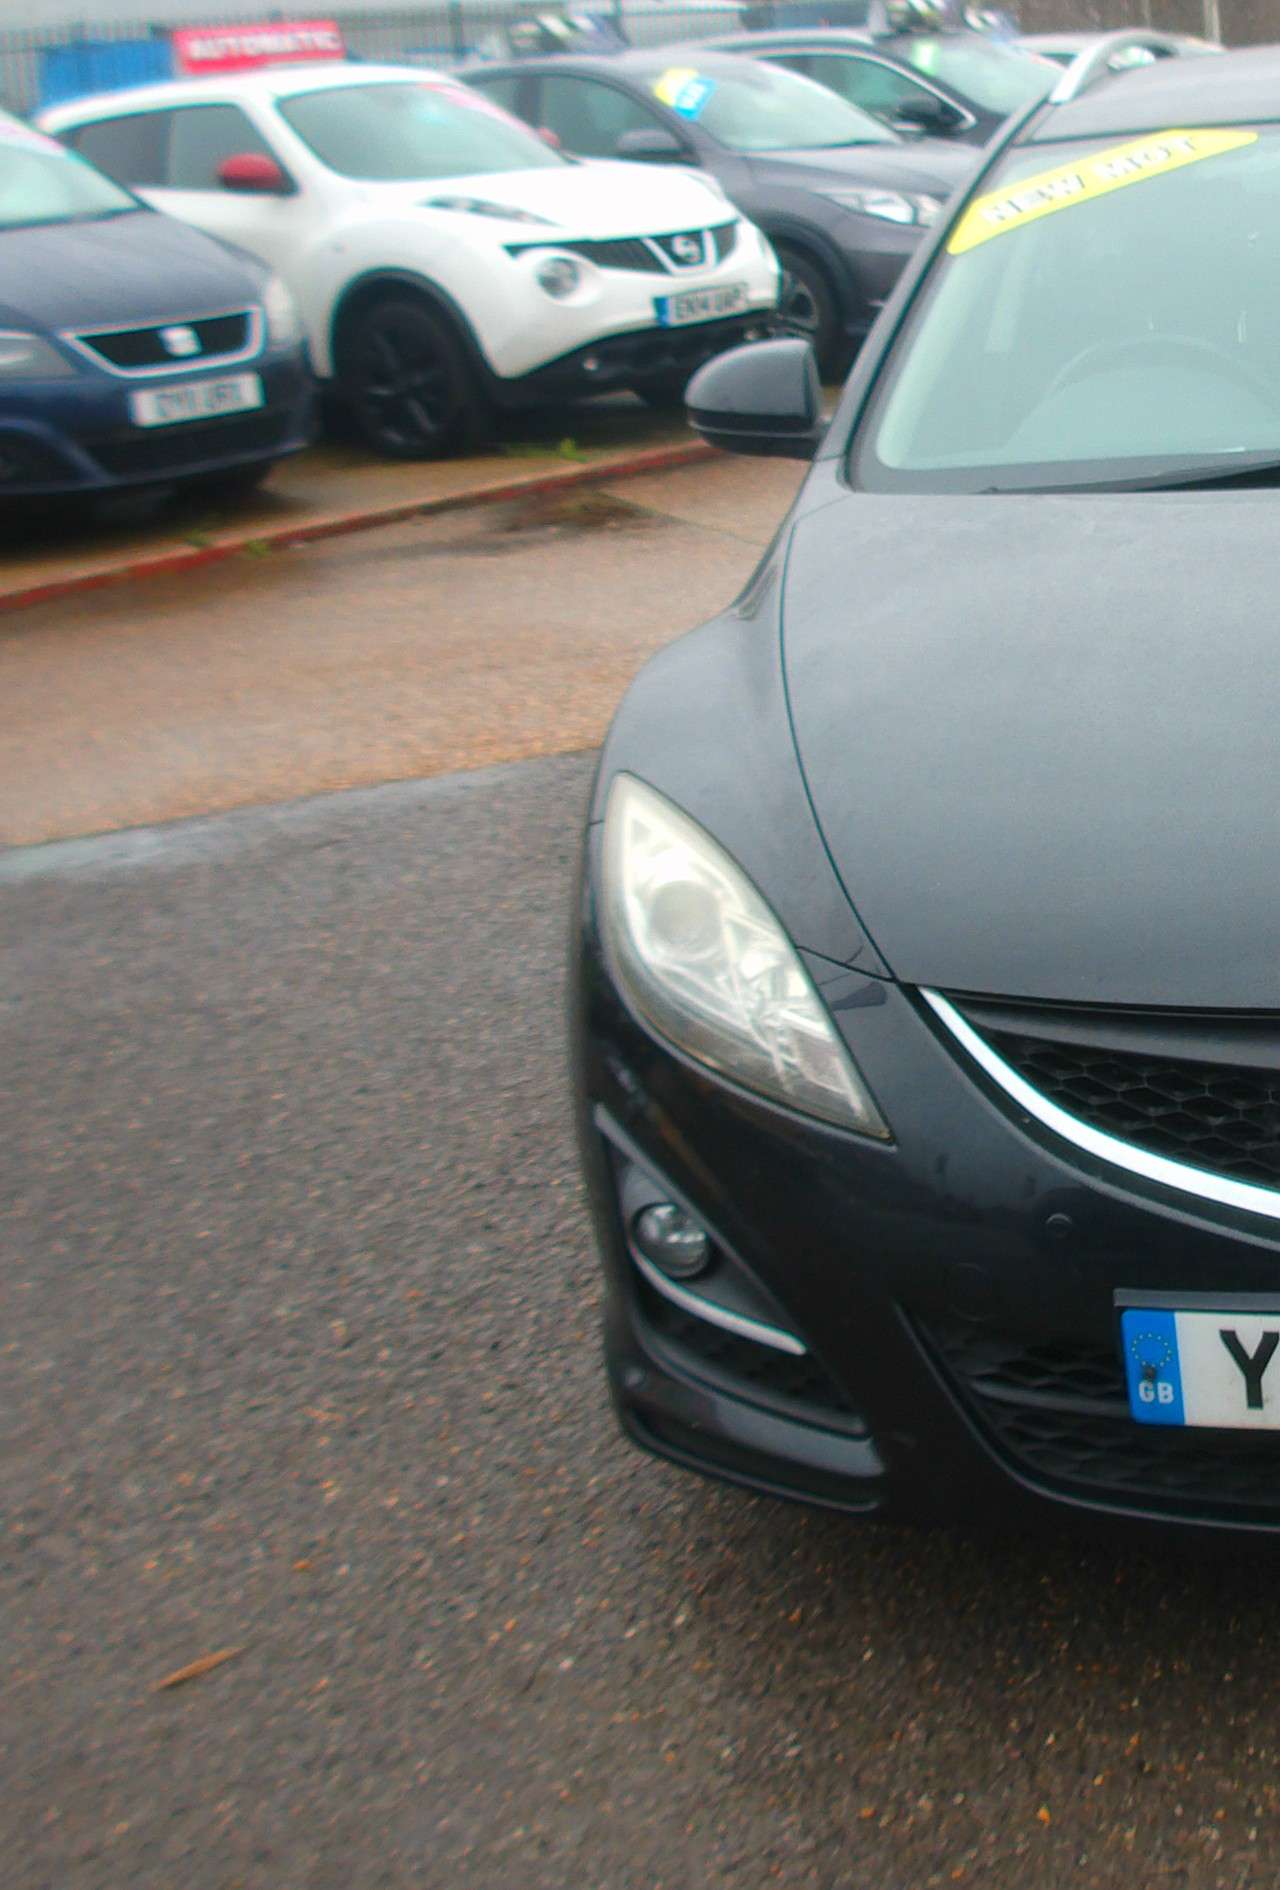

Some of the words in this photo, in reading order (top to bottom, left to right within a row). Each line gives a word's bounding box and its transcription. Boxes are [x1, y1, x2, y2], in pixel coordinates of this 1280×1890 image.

[979, 174, 1086, 223] NEW
[1092, 134, 1197, 181] MOT
[1138, 1380, 1174, 1404] GB
